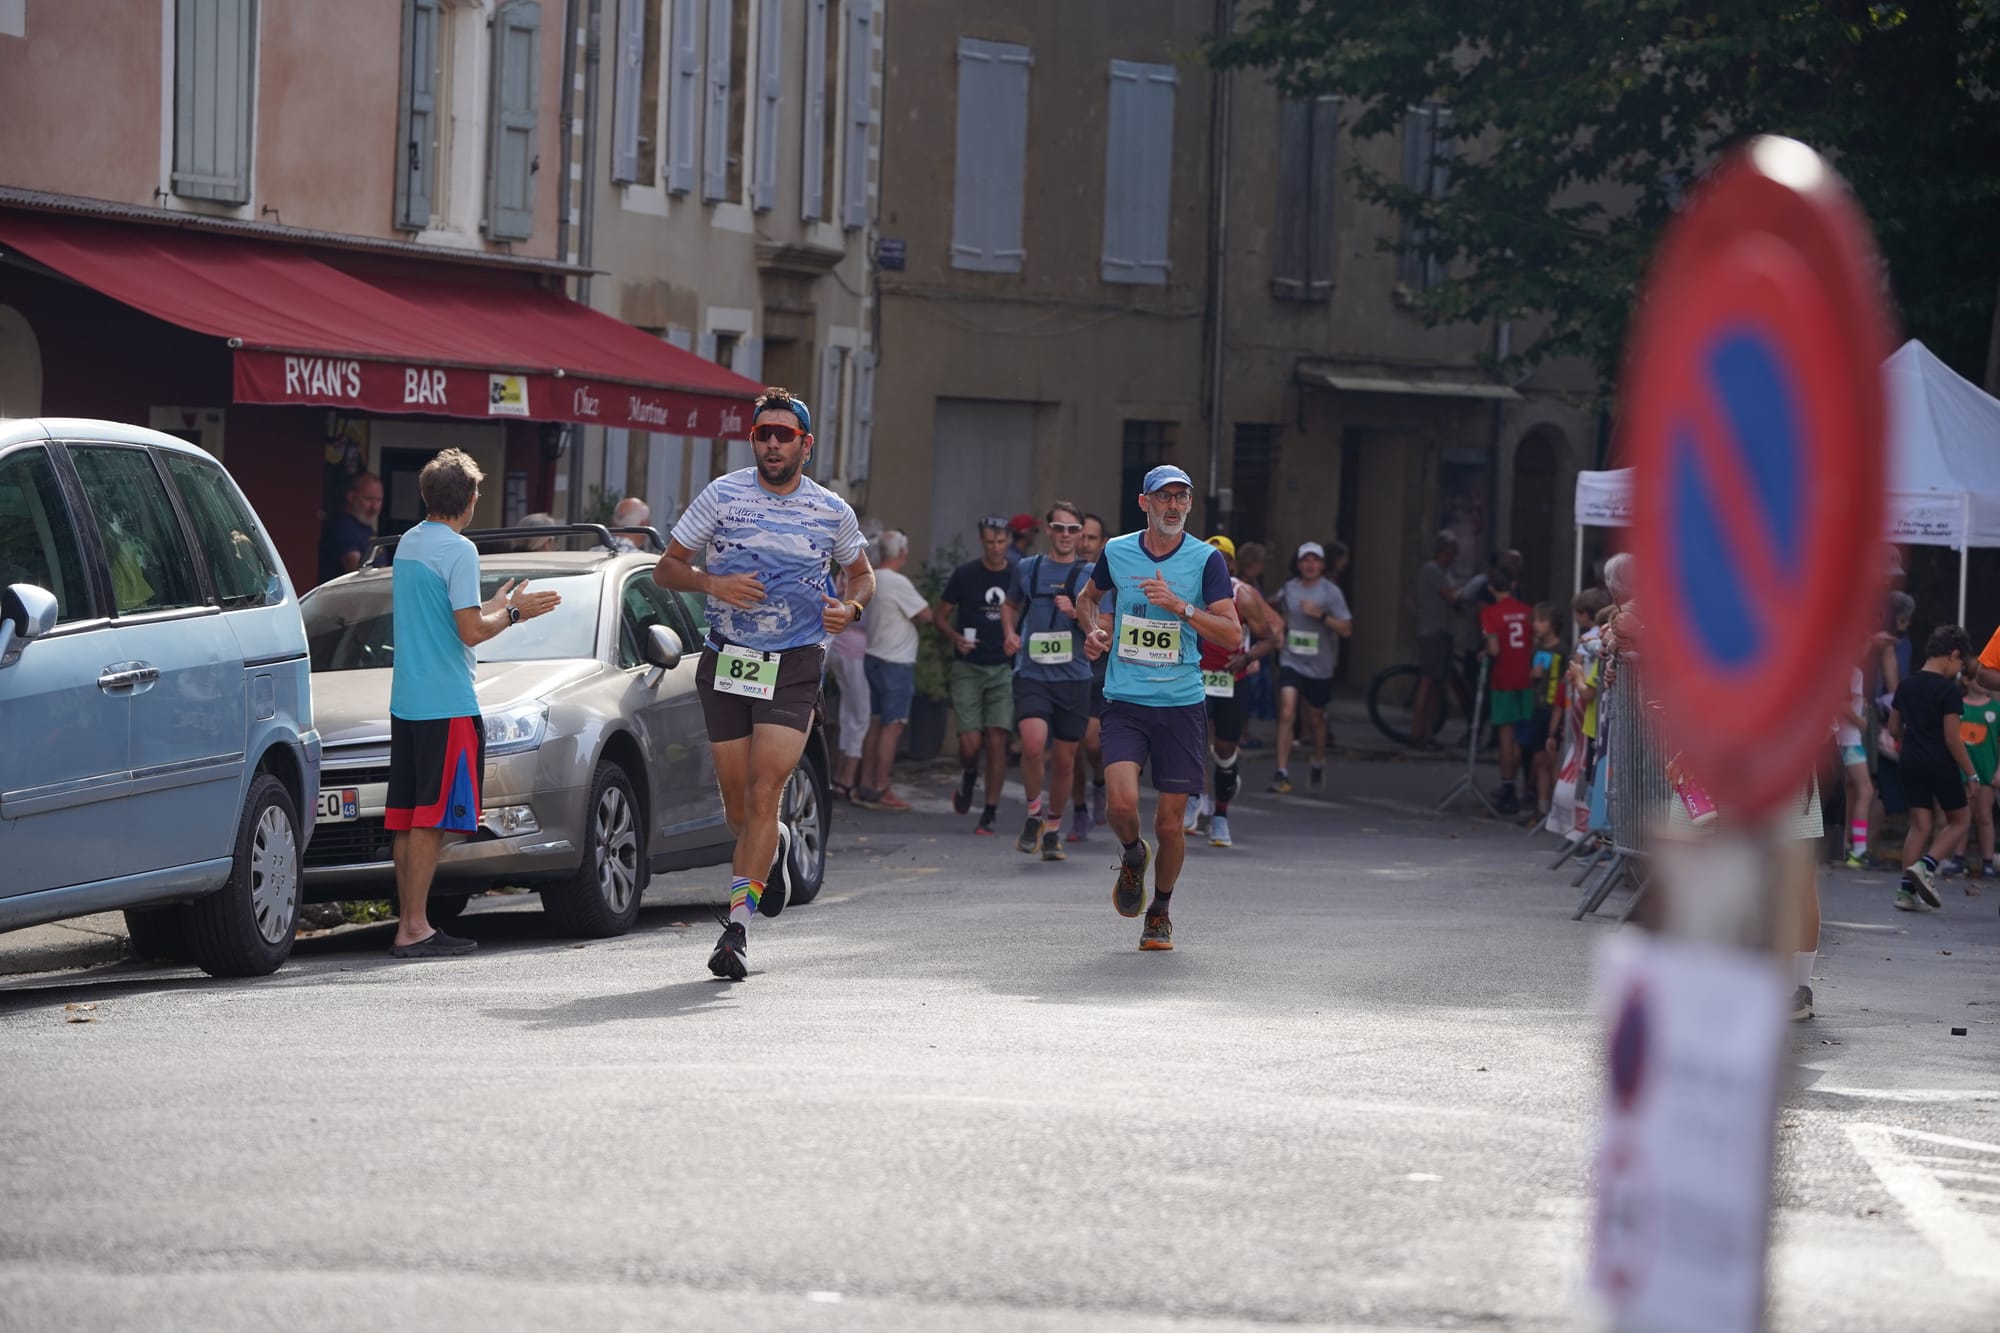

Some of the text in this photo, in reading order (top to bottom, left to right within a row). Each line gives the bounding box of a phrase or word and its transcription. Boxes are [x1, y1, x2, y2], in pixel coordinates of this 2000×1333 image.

[285, 357, 361, 398] RYAN'S
[404, 368, 447, 405] BAR
[574, 386, 742, 436] Chez Martine et John
[1129, 628, 1171, 648] 196
[1508, 622, 1524, 648] 2
[1040, 641, 1061, 653] 30
[730, 659, 760, 681] 82
[344, 804, 356, 816] 48
